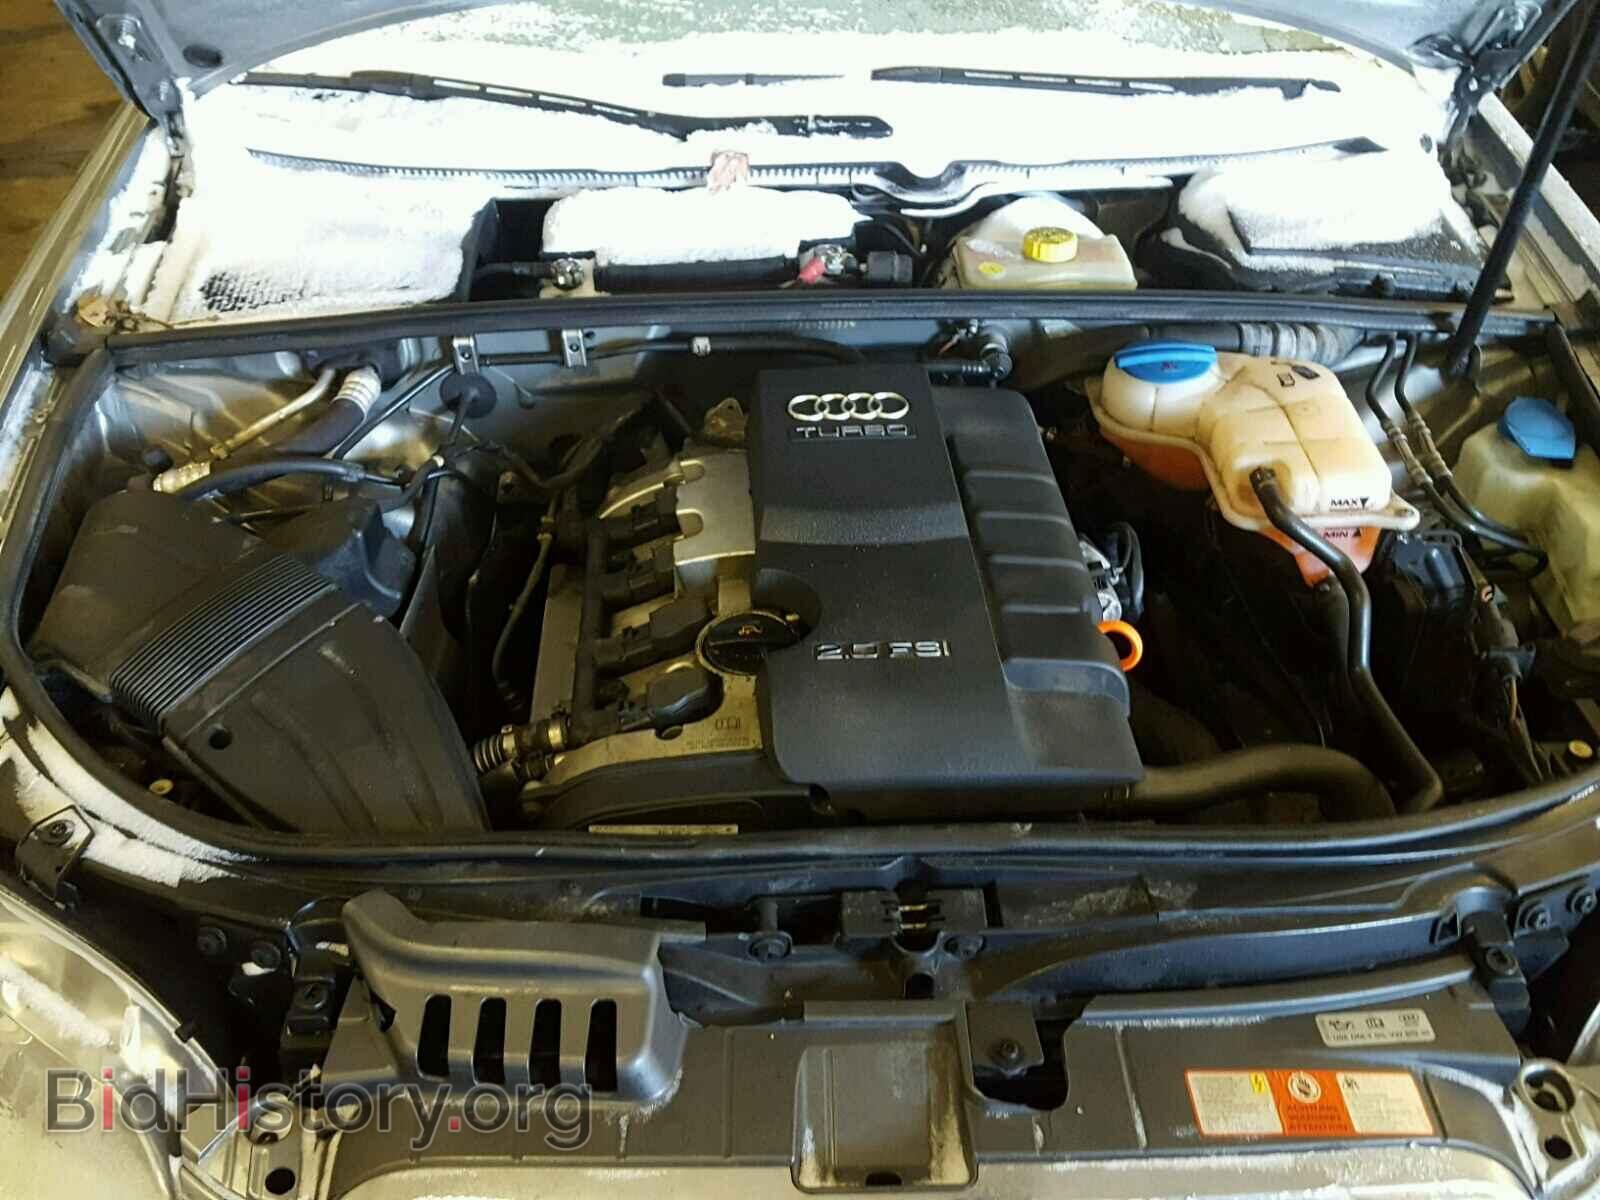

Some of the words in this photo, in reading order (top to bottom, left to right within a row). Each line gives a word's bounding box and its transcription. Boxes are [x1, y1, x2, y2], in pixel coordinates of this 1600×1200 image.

[795, 423, 908, 438] TURBO
[1329, 497, 1358, 507] MAX
[1322, 529, 1349, 539] MIN
[888, 640, 951, 658] FSI
